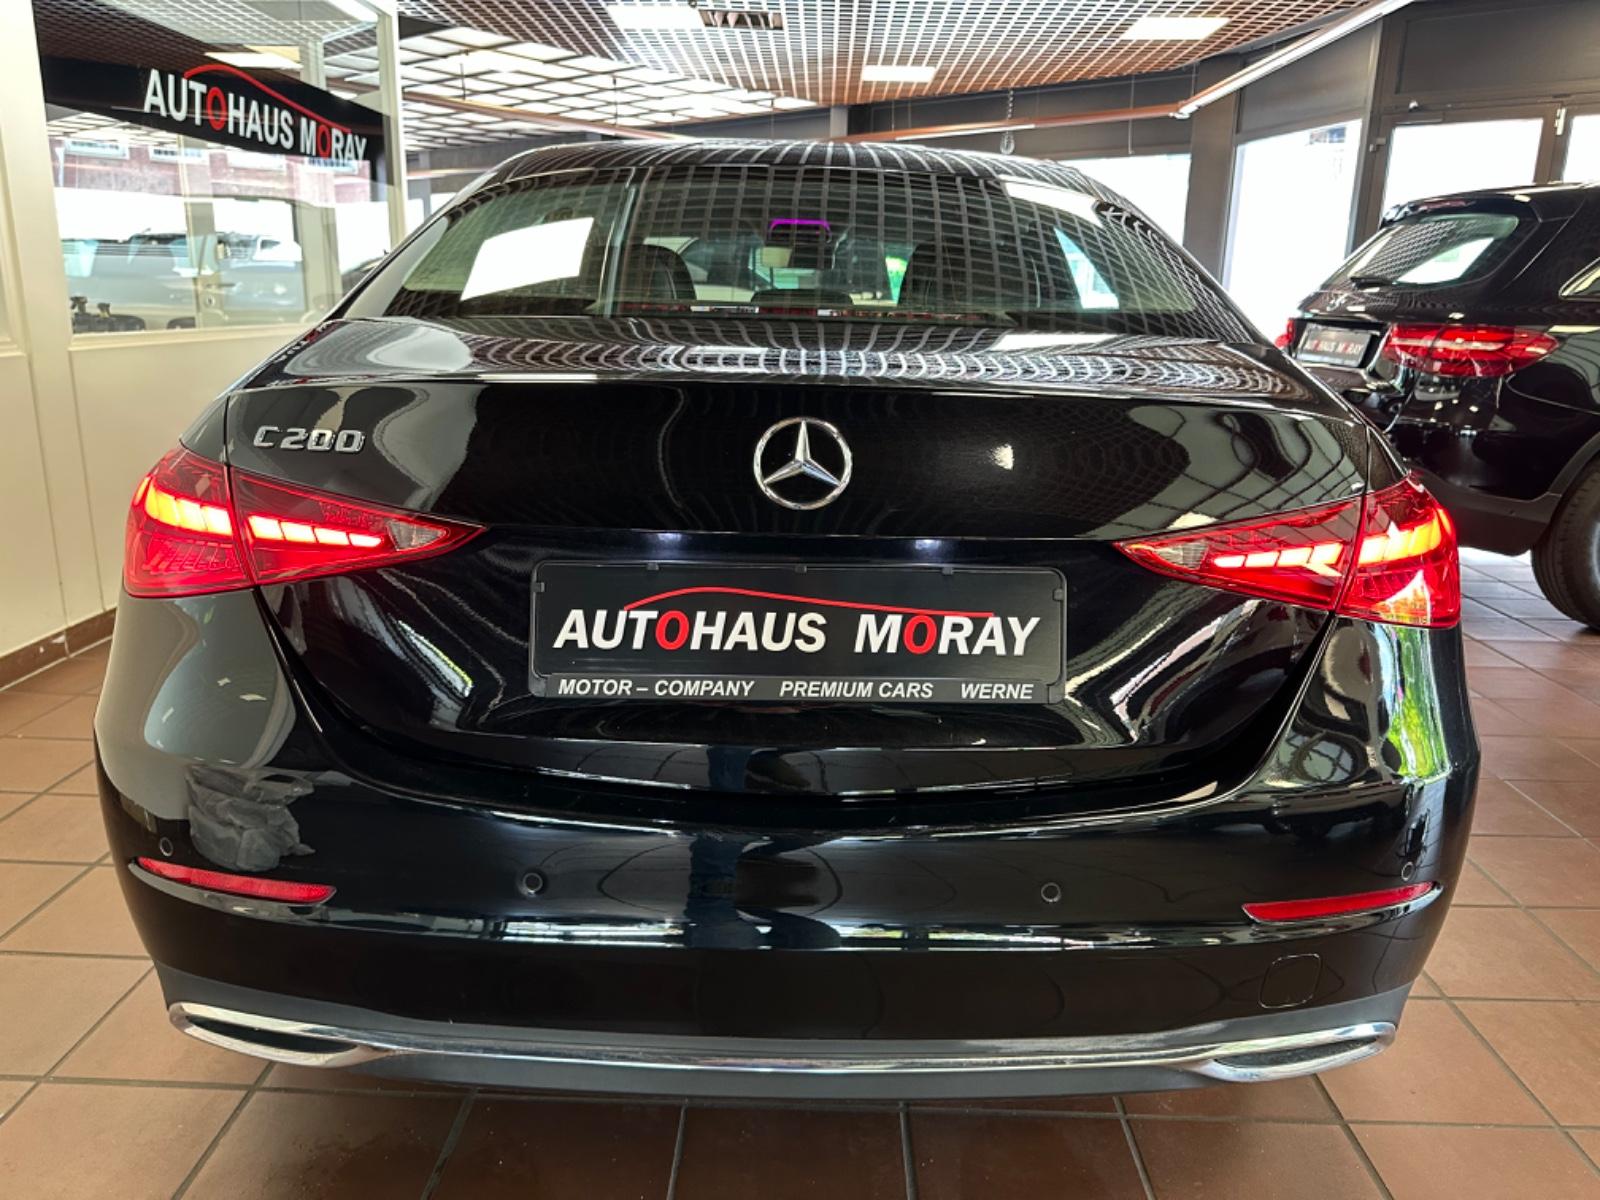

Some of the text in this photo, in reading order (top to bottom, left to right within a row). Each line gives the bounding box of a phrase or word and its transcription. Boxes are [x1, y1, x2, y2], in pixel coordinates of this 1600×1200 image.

[144, 68, 367, 161] AUTOHAUS MORAY
[553, 609, 1041, 656] AUTOHAUS MORAY
[558, 679, 632, 695] MOTOR
[655, 680, 754, 697] COMPANY
[780, 680, 873, 698] PREMIUM
[878, 682, 934, 698] CARS
[961, 683, 1034, 699] WERNE
